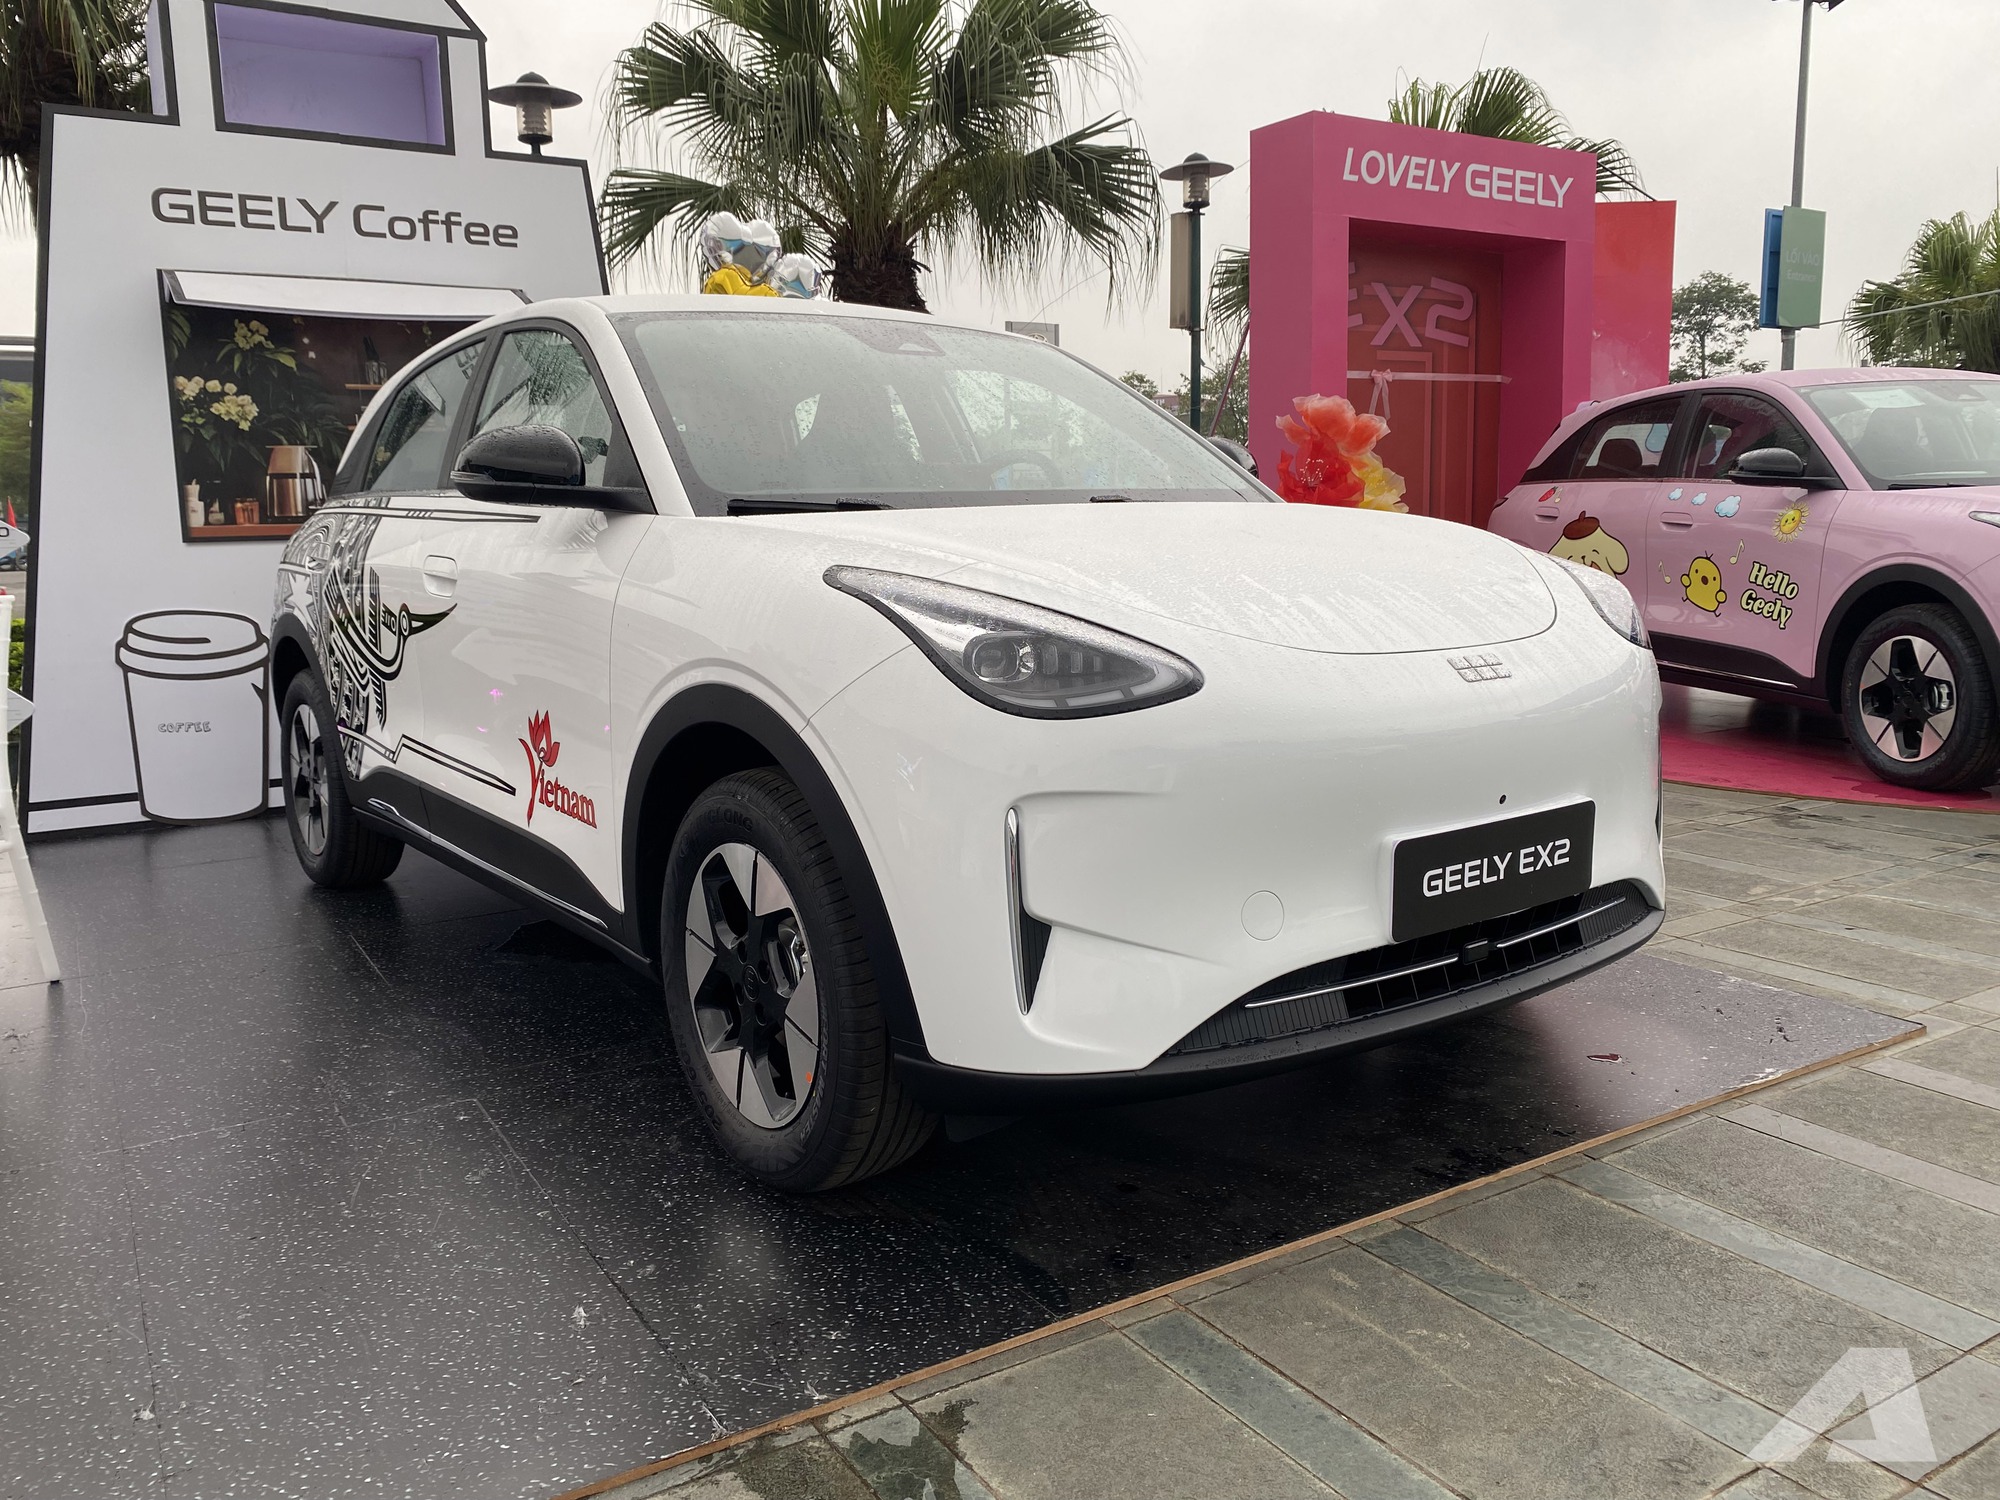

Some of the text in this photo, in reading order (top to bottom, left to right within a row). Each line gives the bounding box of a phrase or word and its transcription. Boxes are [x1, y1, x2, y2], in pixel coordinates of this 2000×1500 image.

[1343, 147, 1574, 208] LOVELY GEELY
[151, 187, 519, 248] GEELY Coffee
[1740, 588, 1793, 630] Geely
[1748, 561, 1799, 600] Hello
[158, 721, 212, 733] COFFEE
[518, 737, 598, 830] Vietnam
[1423, 838, 1571, 898] GEELY EX2
